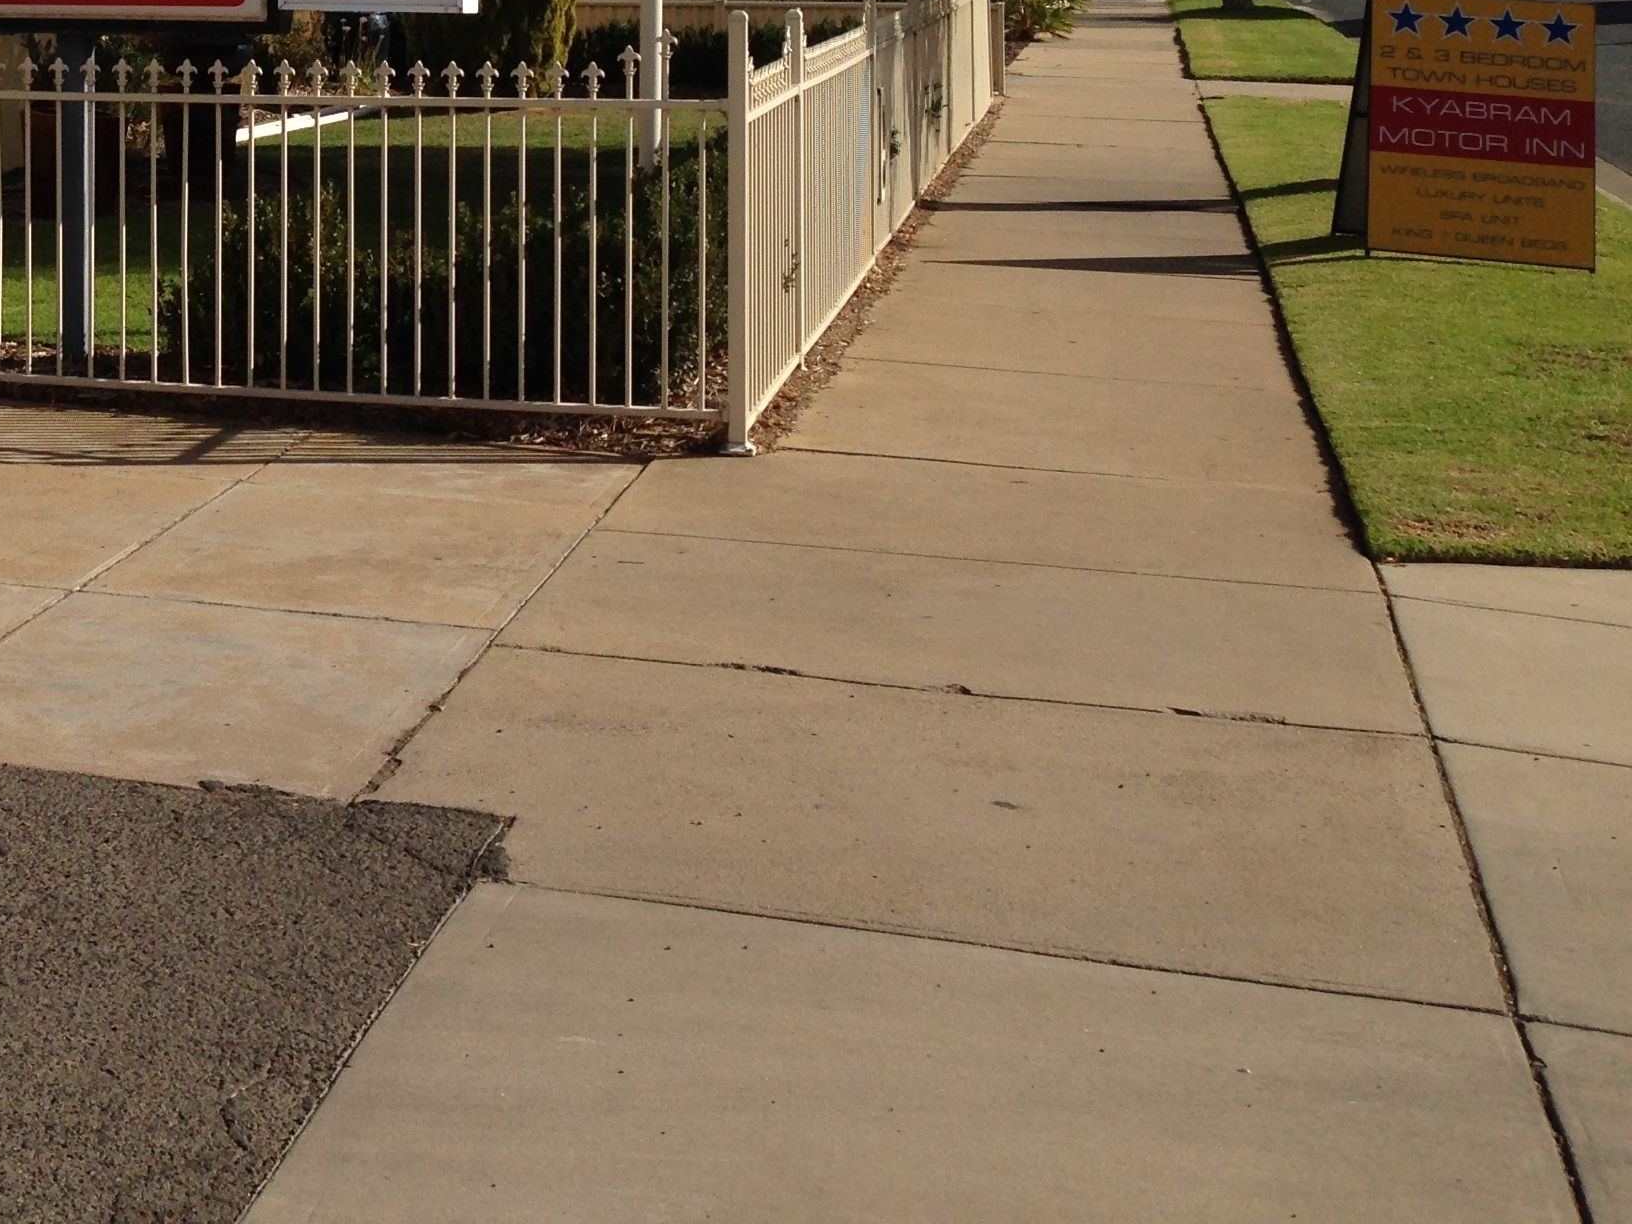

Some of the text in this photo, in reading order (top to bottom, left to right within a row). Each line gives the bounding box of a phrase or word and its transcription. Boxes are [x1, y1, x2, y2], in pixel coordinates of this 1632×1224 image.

[1380, 45, 1586, 72] 2 & 3 BEDROOM
[1387, 66, 1577, 93] TOWN HOUSES
[1393, 96, 1570, 126] KYABRAM
[1379, 126, 1585, 159] MOTOR INN
[1380, 165, 1585, 190] WIRELESS BROADBAND
[1417, 188, 1545, 208] LUXURY UNITS
[1482, 215, 1520, 225] UNIT
[1392, 228, 1433, 239] KING
[1455, 232, 1514, 246] QUEEN
